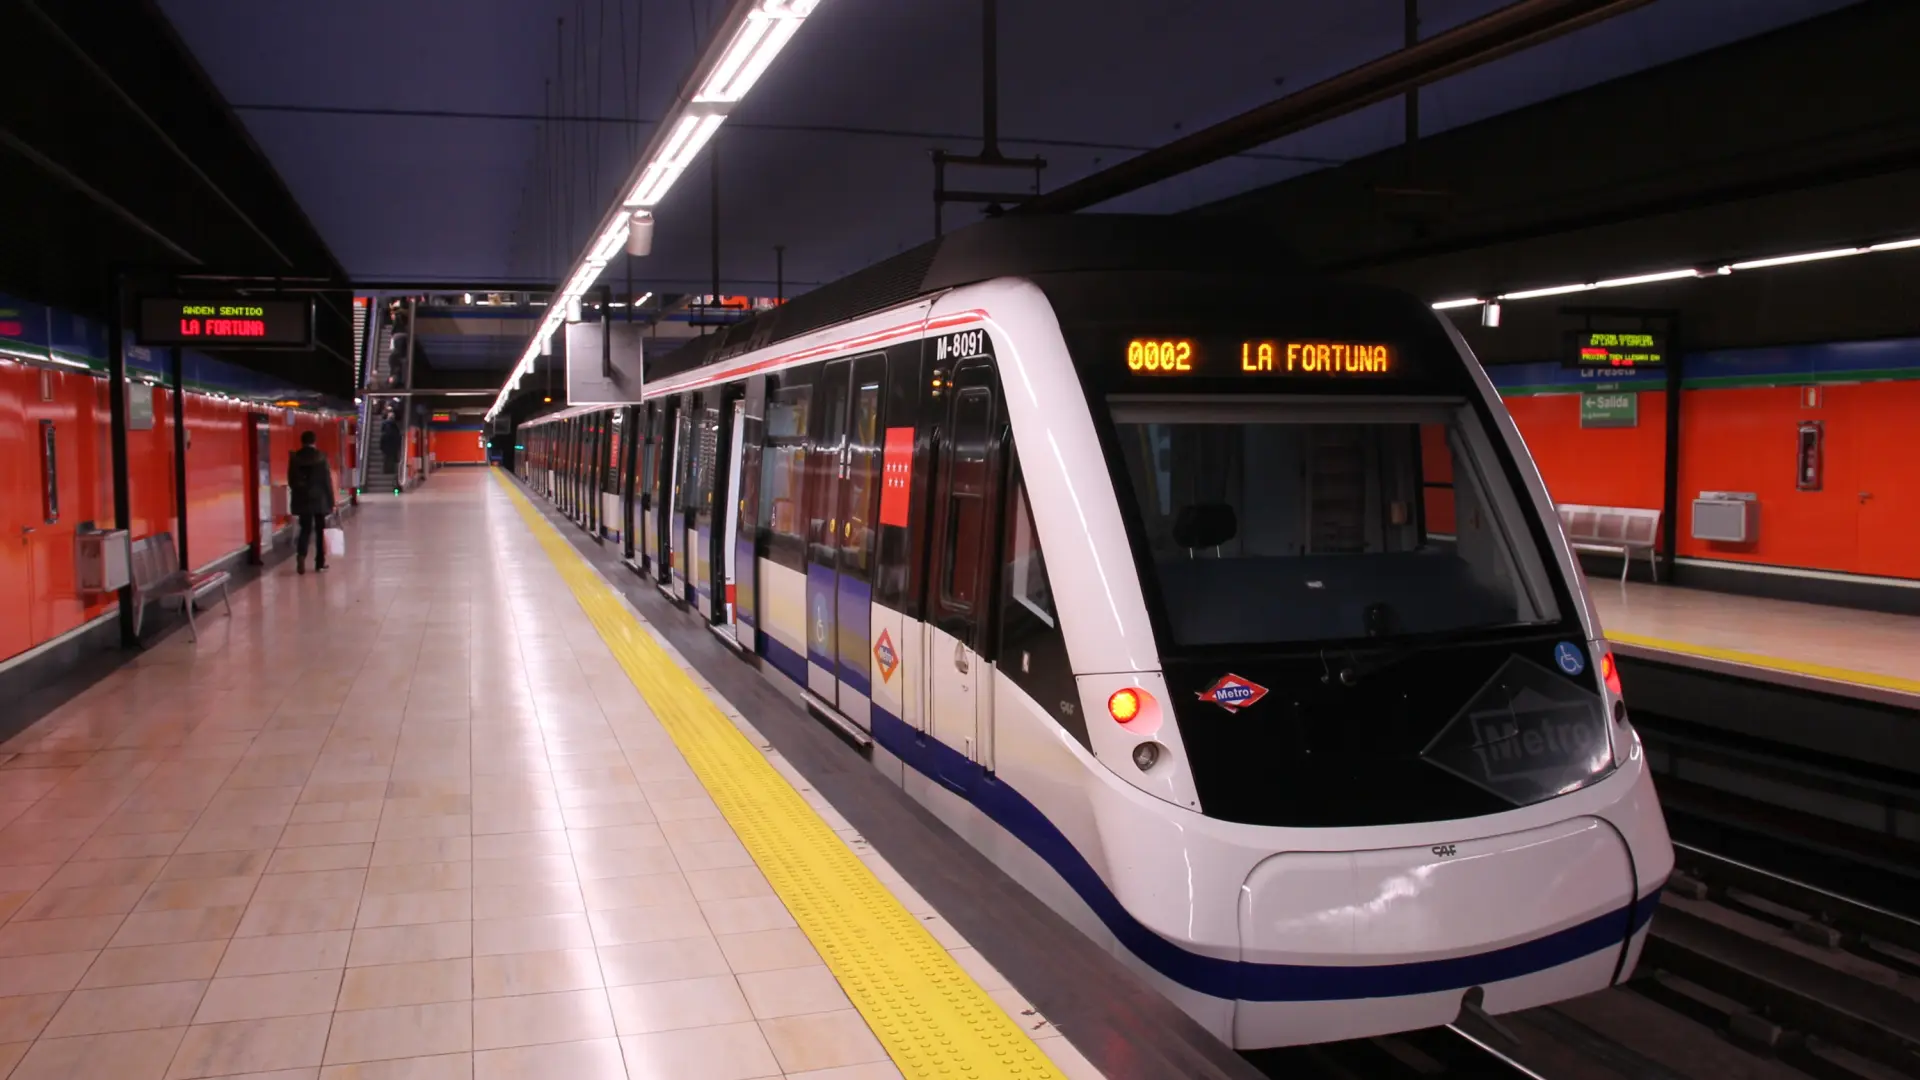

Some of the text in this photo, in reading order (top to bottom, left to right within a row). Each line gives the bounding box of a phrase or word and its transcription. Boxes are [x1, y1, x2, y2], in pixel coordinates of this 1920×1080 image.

[182, 305, 264, 316] ANDEN SENTIDO
[180, 319, 265, 336] LA FORTUNA
[937, 330, 983, 361] M-8091
[1128, 341, 1387, 372] 0002 LA FORTUNA
[1597, 396, 1629, 409] Salida
[1217, 687, 1250, 700] Metro
[1485, 717, 1591, 761] Metro
[1432, 845, 1456, 857] CAF
